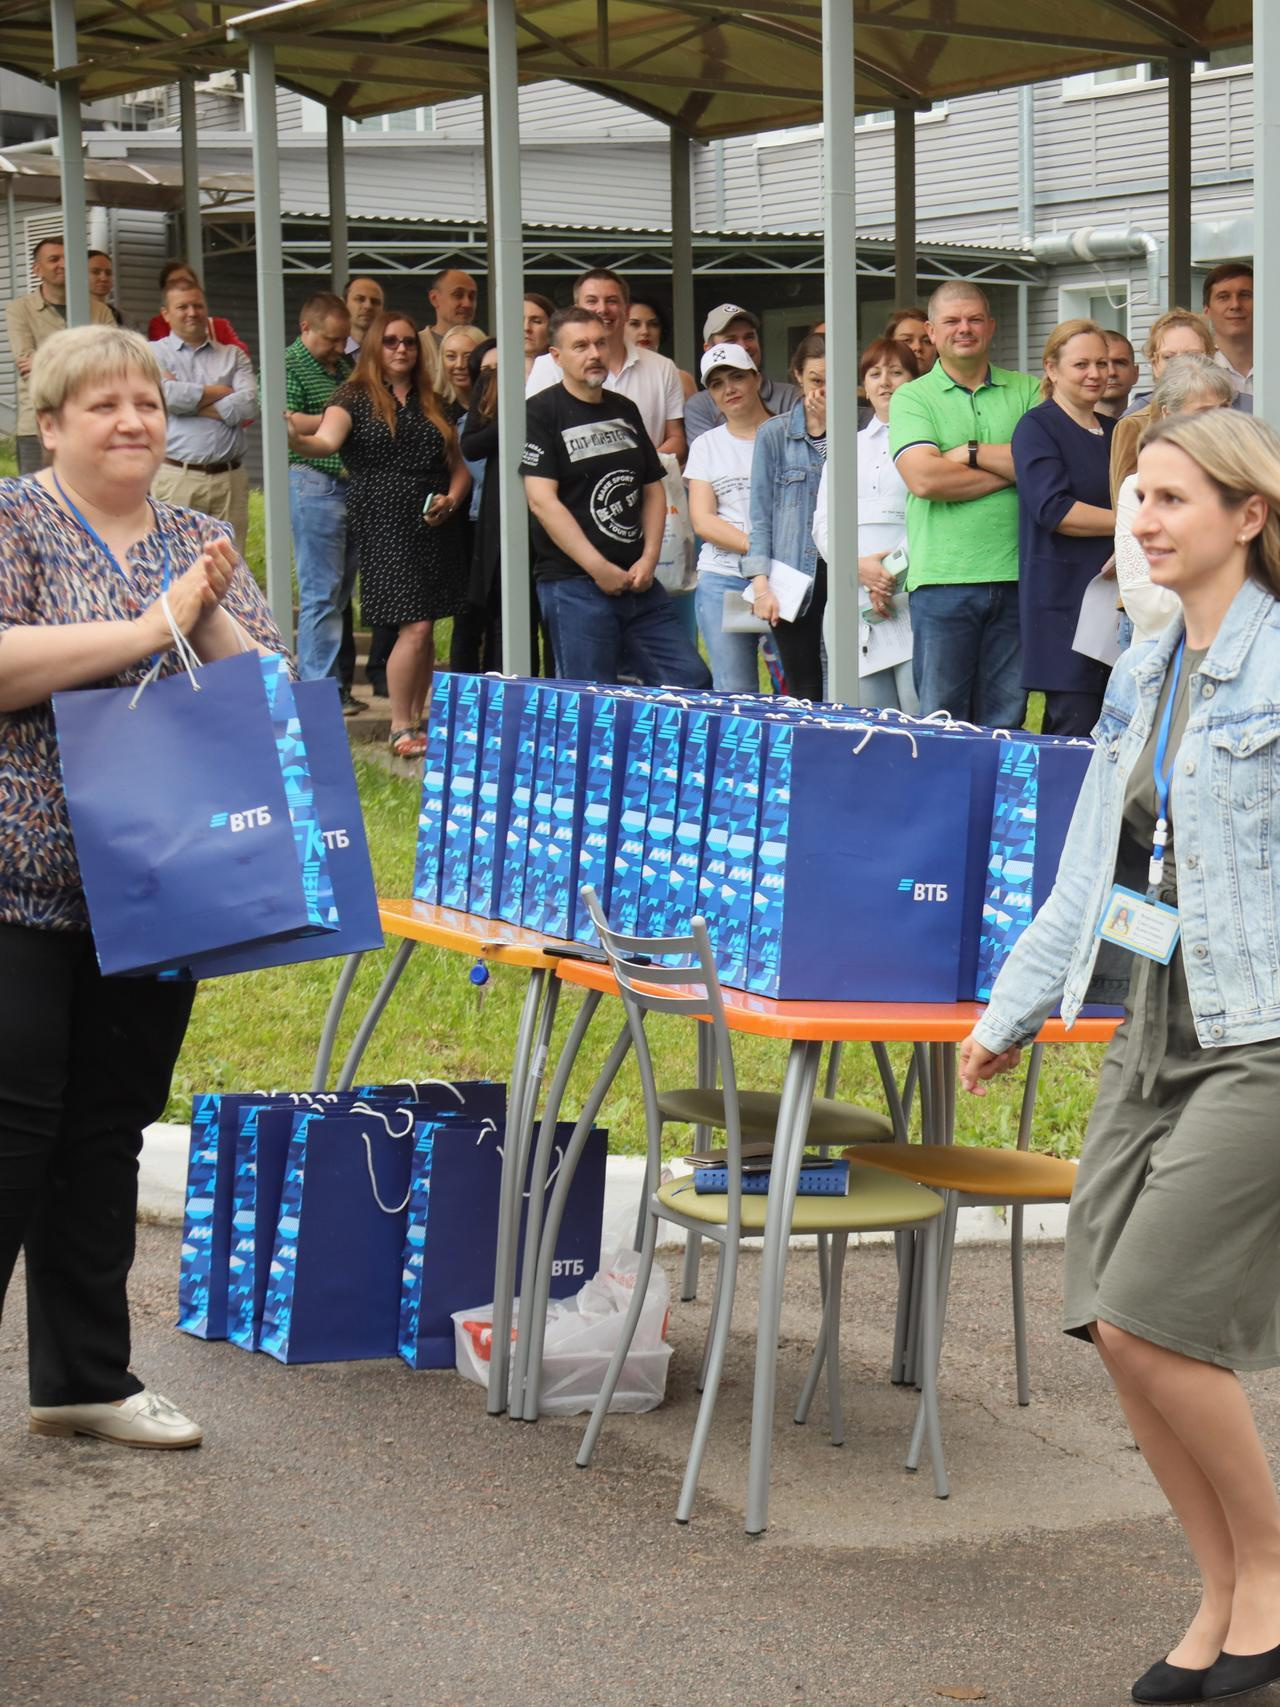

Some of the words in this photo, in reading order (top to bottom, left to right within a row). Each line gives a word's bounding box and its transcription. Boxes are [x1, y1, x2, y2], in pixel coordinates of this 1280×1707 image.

[596, 480, 613, 501] MAKE
[611, 475, 634, 484] SPORT
[609, 522, 627, 537] YOUR
[229, 805, 272, 833] ВТБ
[321, 829, 350, 850] ТБ
[913, 883, 948, 902] ВТБ
[551, 1259, 585, 1277] ВТБ
